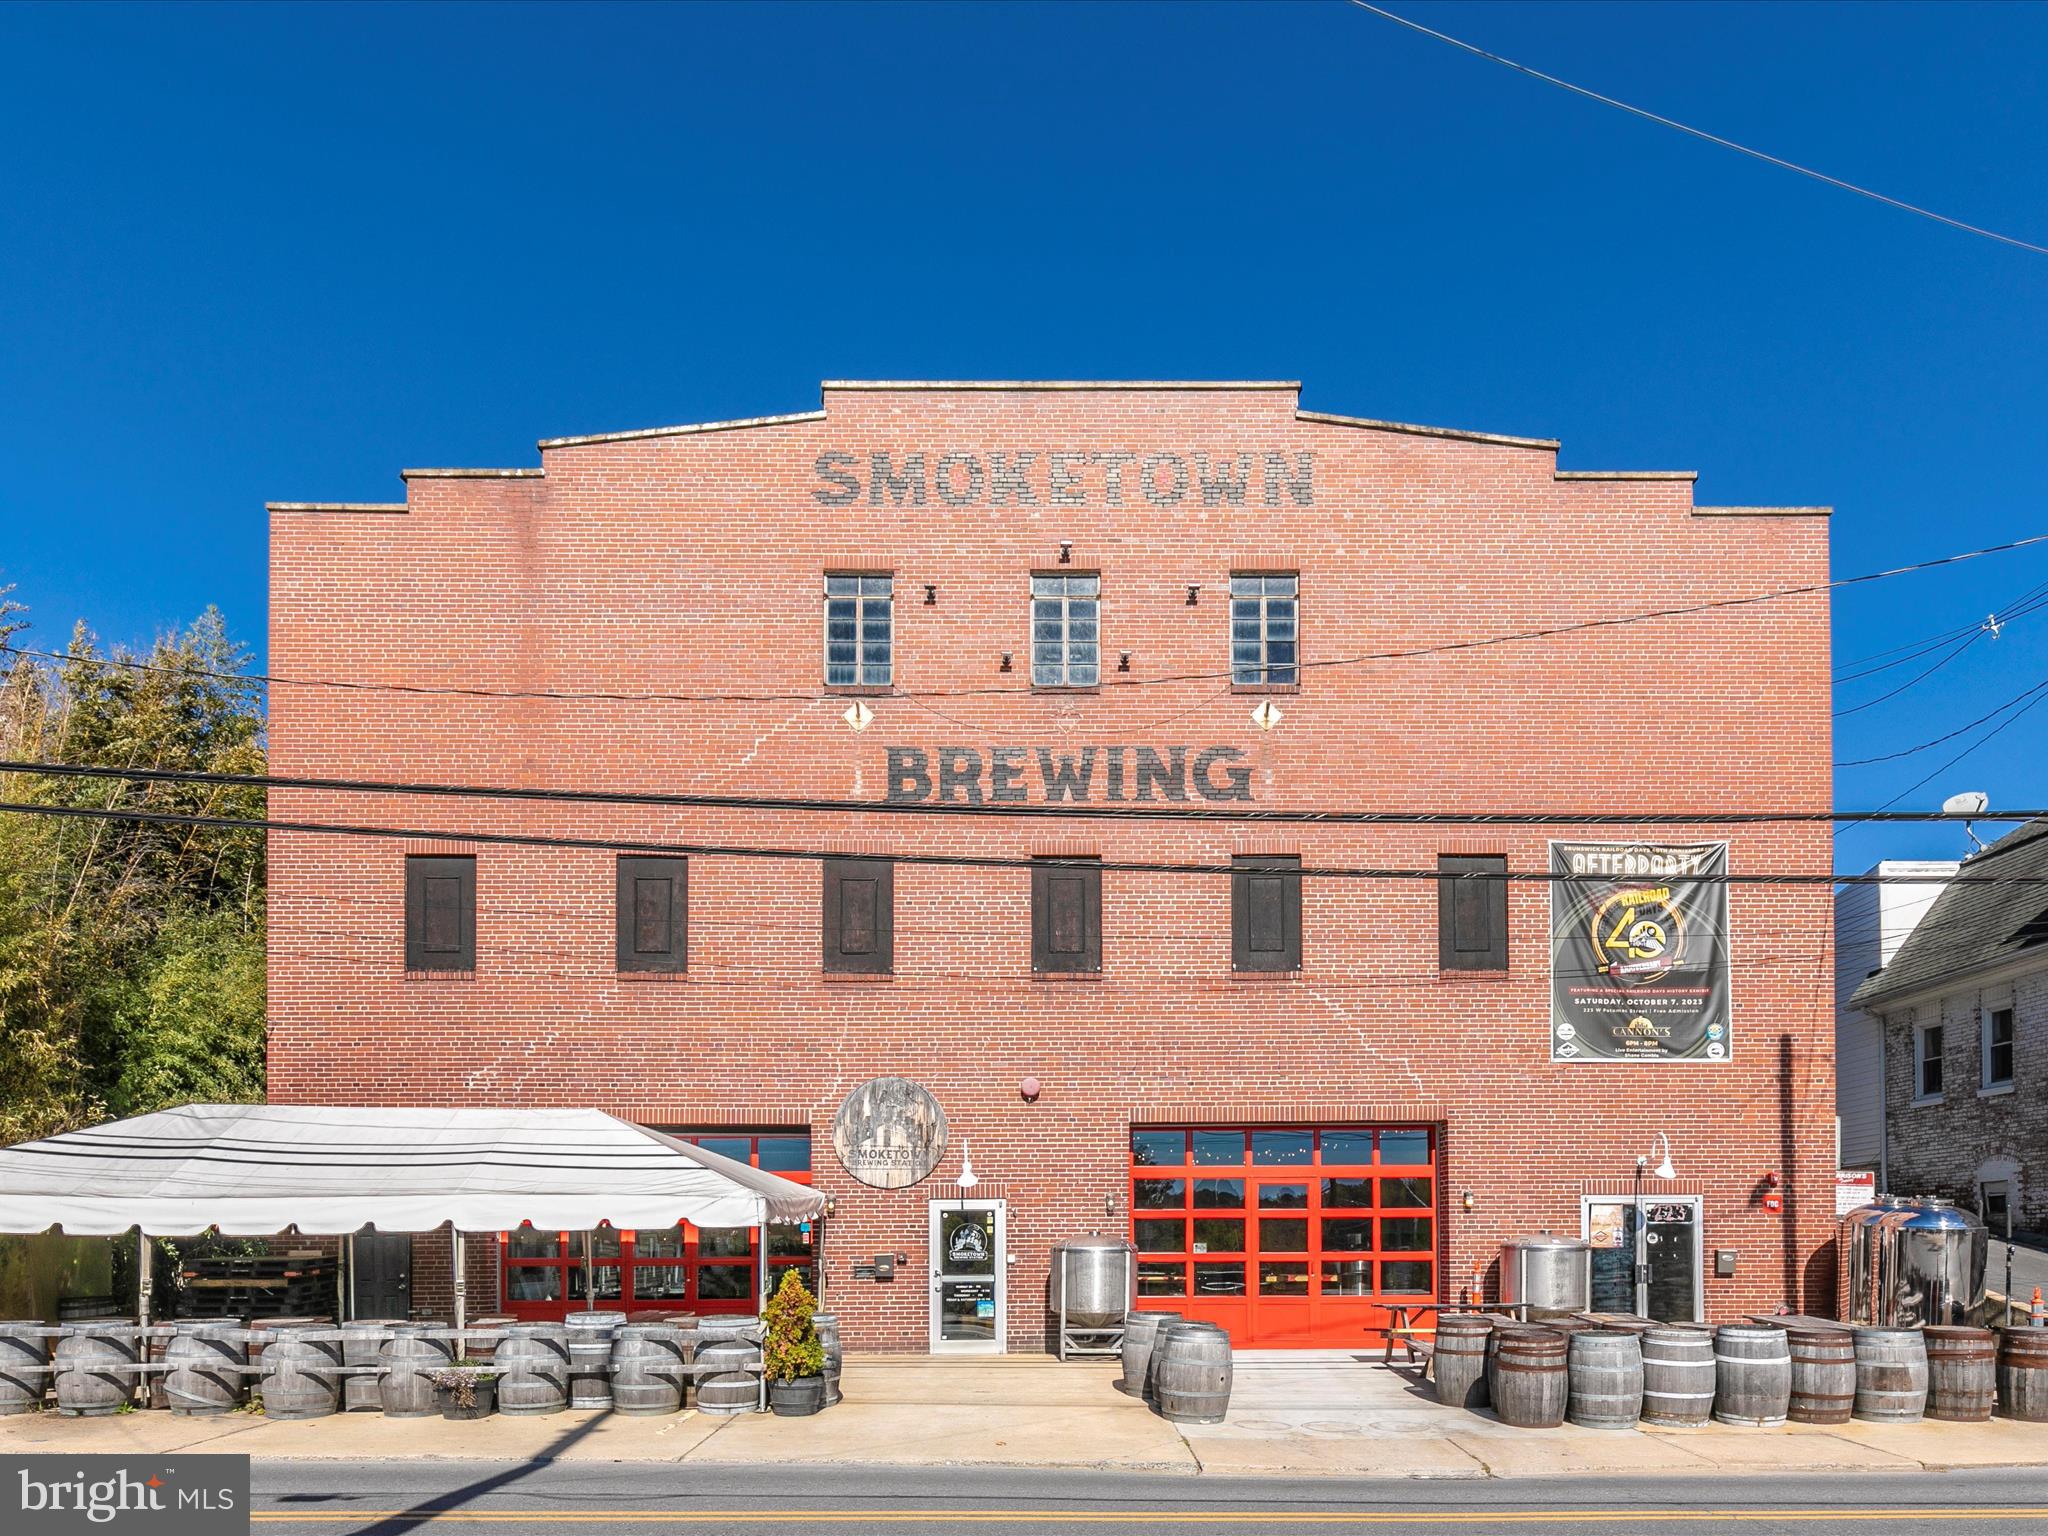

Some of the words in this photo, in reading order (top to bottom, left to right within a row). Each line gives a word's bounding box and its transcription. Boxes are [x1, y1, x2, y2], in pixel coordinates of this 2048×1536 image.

[811, 450, 1317, 508] SMOKETOWN
[882, 744, 1256, 803] BREWING
[1572, 853, 1702, 875] AFTERPARTY
[1620, 887, 1670, 907] RAILROAD
[1612, 1027, 1671, 1037] CANNON'S
[849, 1149, 928, 1160] SMOKETOW
[891, 1159, 927, 1167] STATIO
